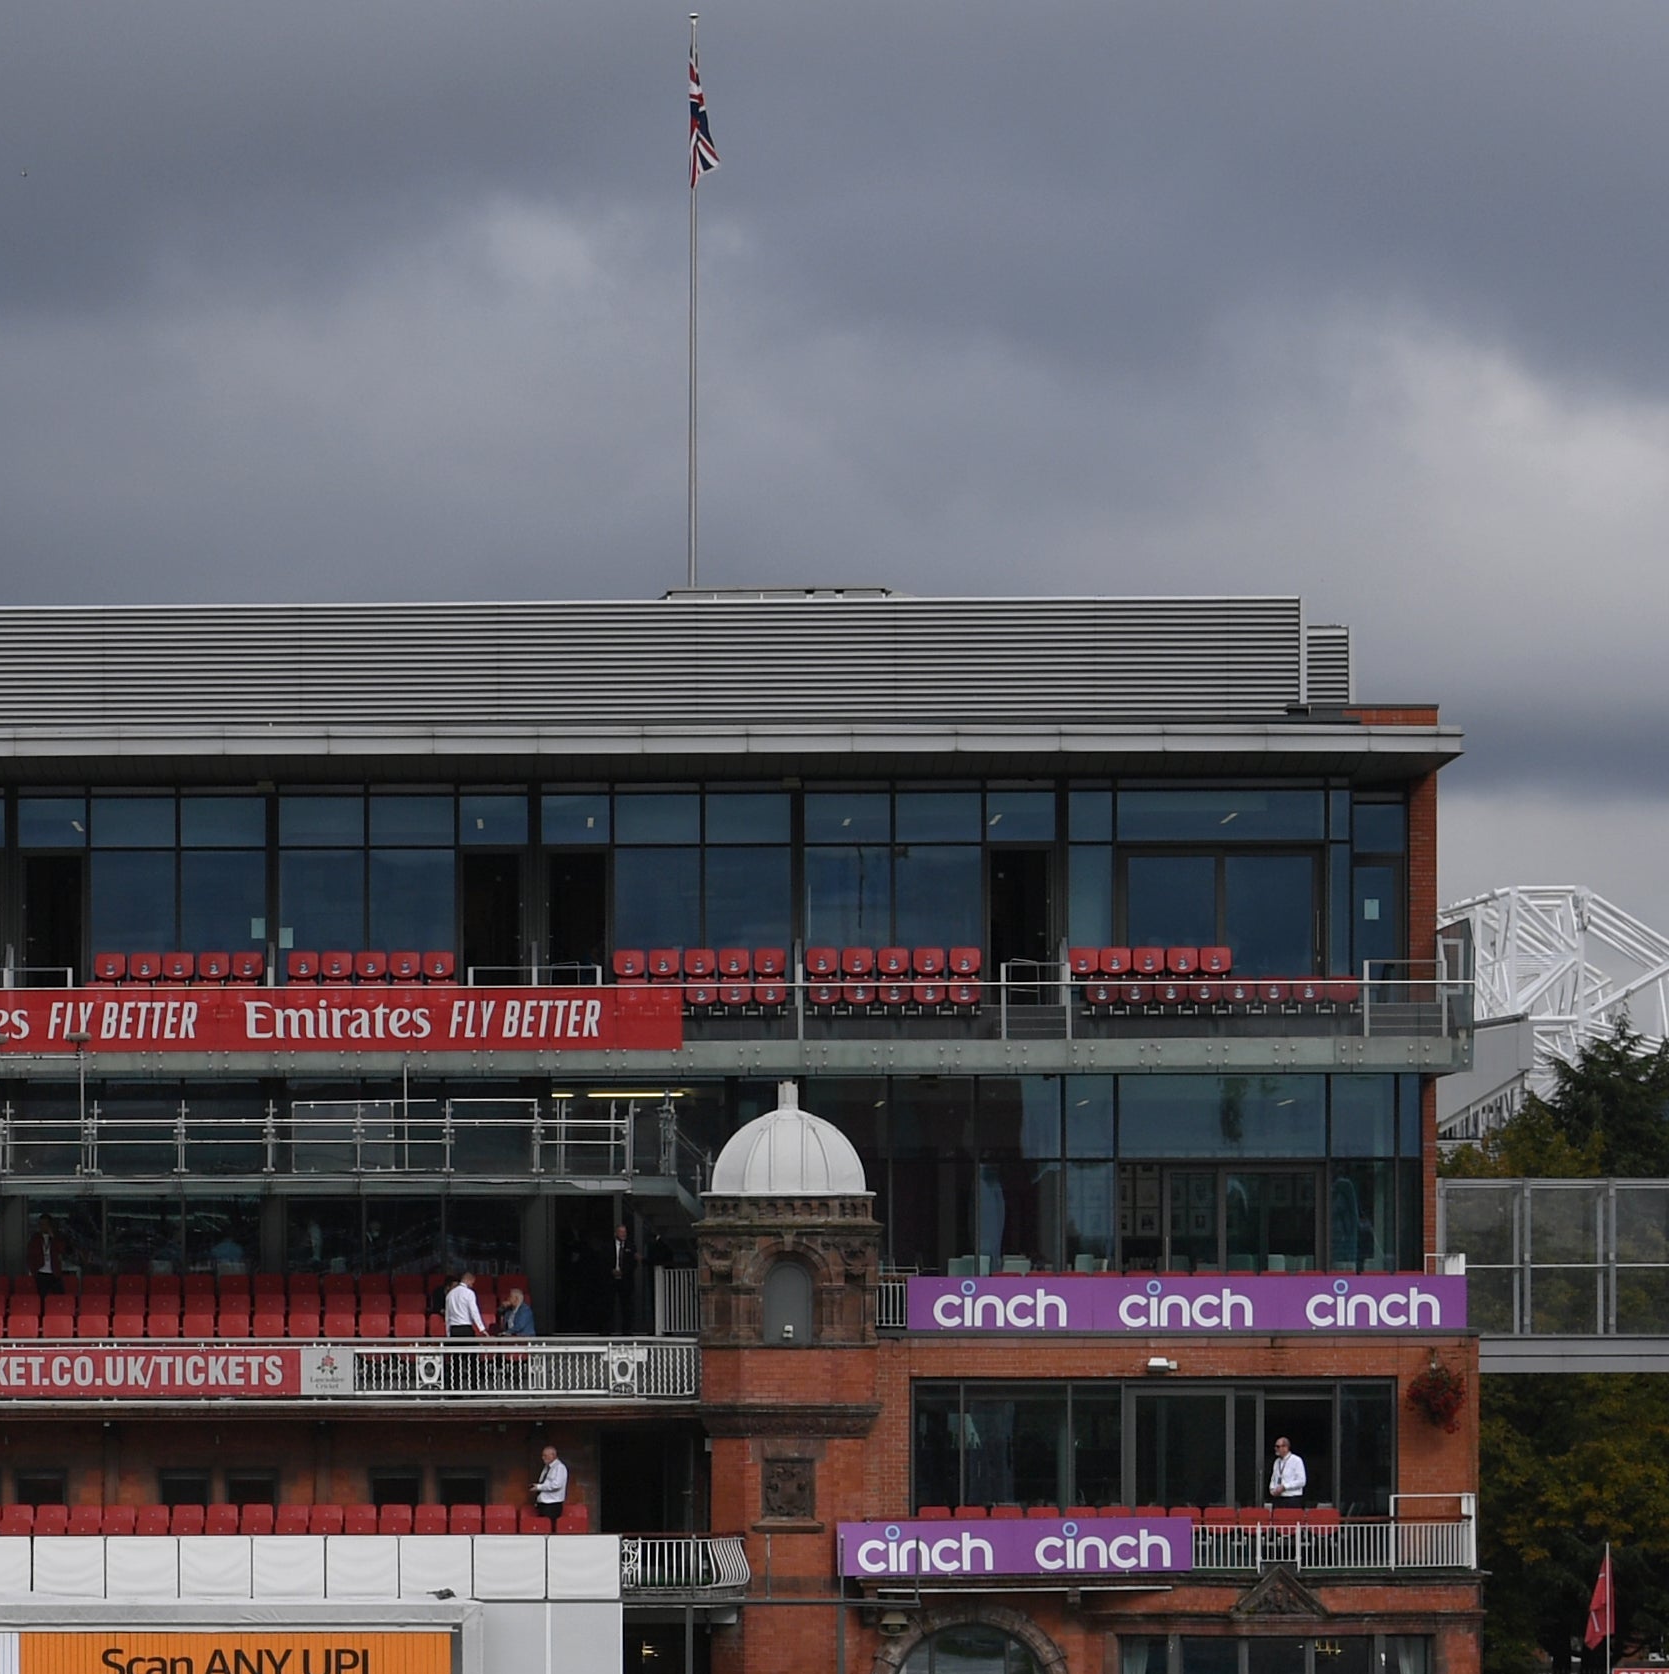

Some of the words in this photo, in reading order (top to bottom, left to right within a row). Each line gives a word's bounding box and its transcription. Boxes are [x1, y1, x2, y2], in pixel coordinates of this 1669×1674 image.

[47, 1001, 94, 1040] FLY
[100, 1001, 198, 1040] BETTER
[244, 999, 431, 1039] Emirates
[448, 1000, 495, 1038] FLY
[501, 1000, 601, 1038] BETTER
[932, 1279, 1068, 1329] cinch
[1118, 1278, 1253, 1328] cinch
[1306, 1278, 1441, 1327] cinch
[857, 1524, 994, 1573] cinch
[1034, 1521, 1172, 1570] cinch
